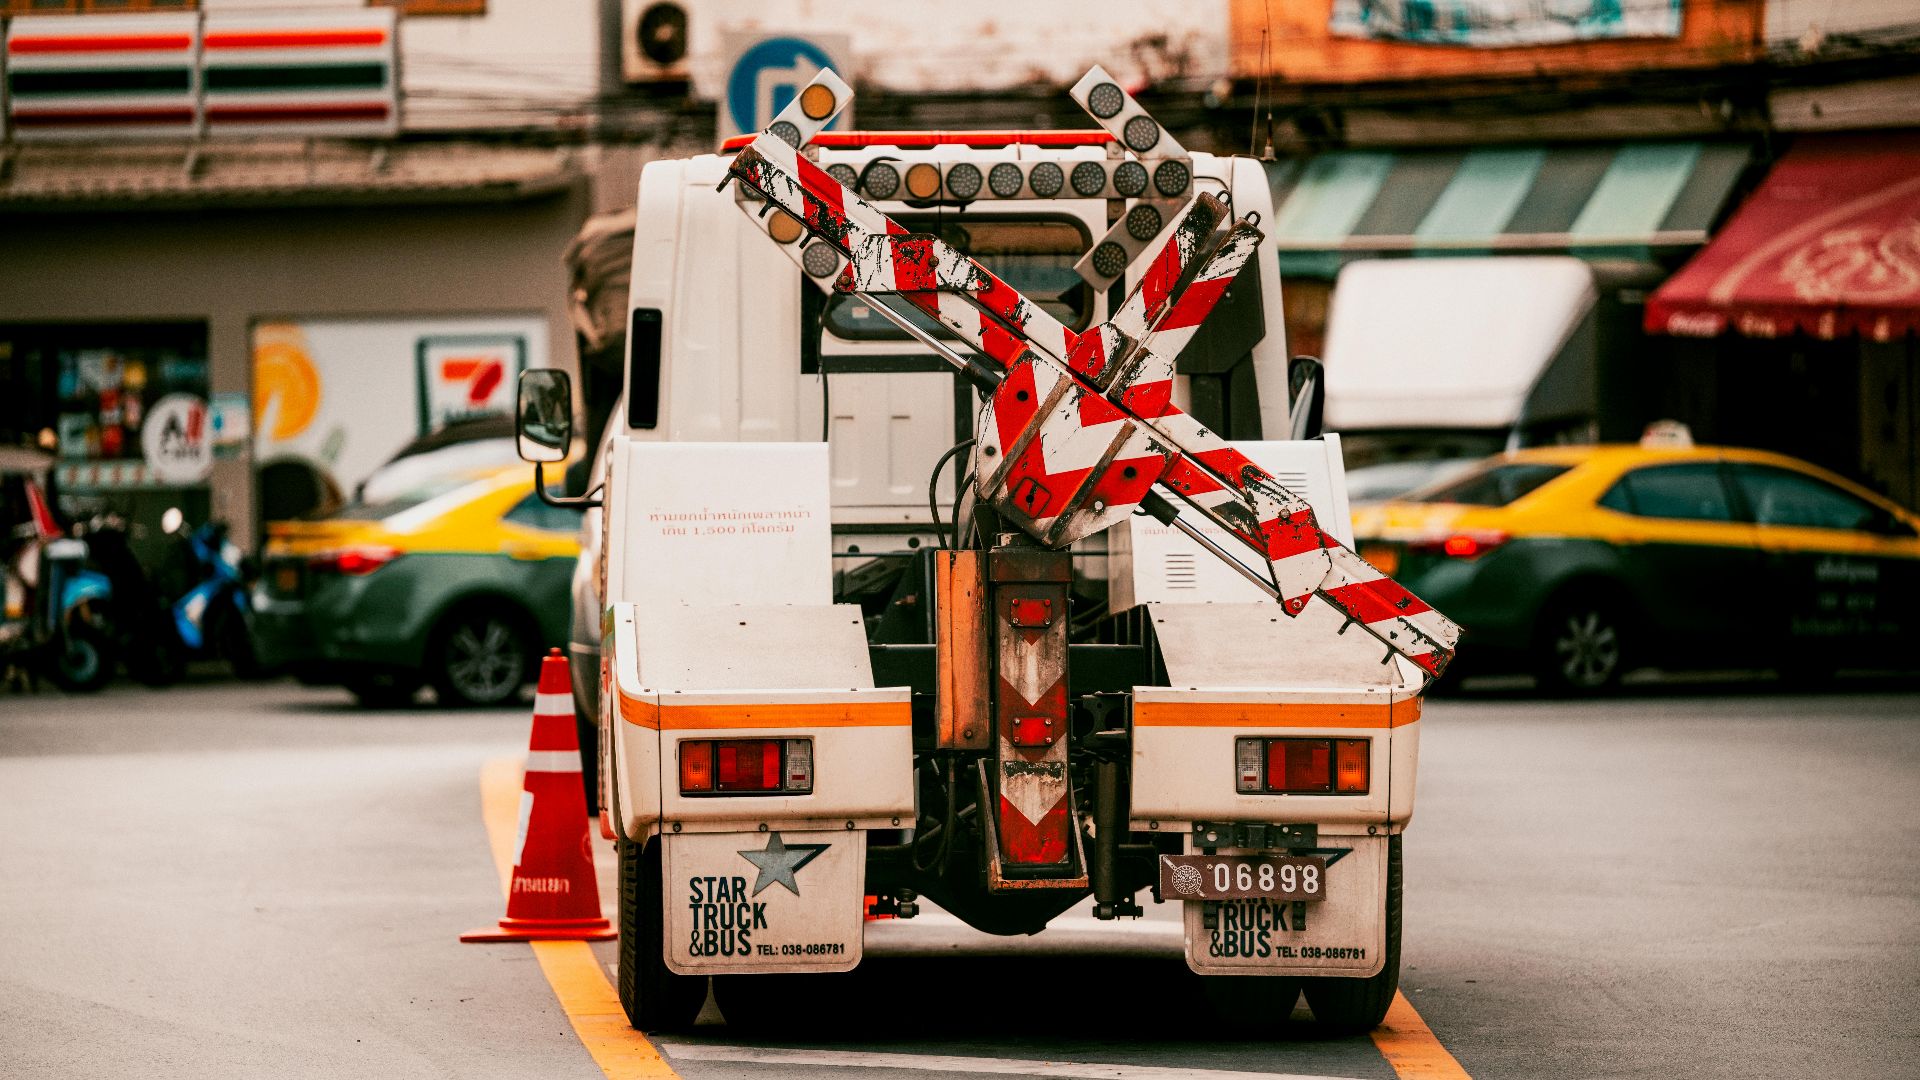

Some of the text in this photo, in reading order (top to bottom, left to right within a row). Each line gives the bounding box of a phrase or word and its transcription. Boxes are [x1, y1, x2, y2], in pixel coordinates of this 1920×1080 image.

[689, 876, 747, 903] STAR
[1214, 863, 1319, 893] 06898
[689, 903, 768, 929] TRUCK
[689, 930, 751, 957] &BUS
[757, 943, 844, 956] TEL: 038-086781
[1210, 930, 1271, 958] &BUS
[1276, 946, 1365, 959] TEL: 038-086781
